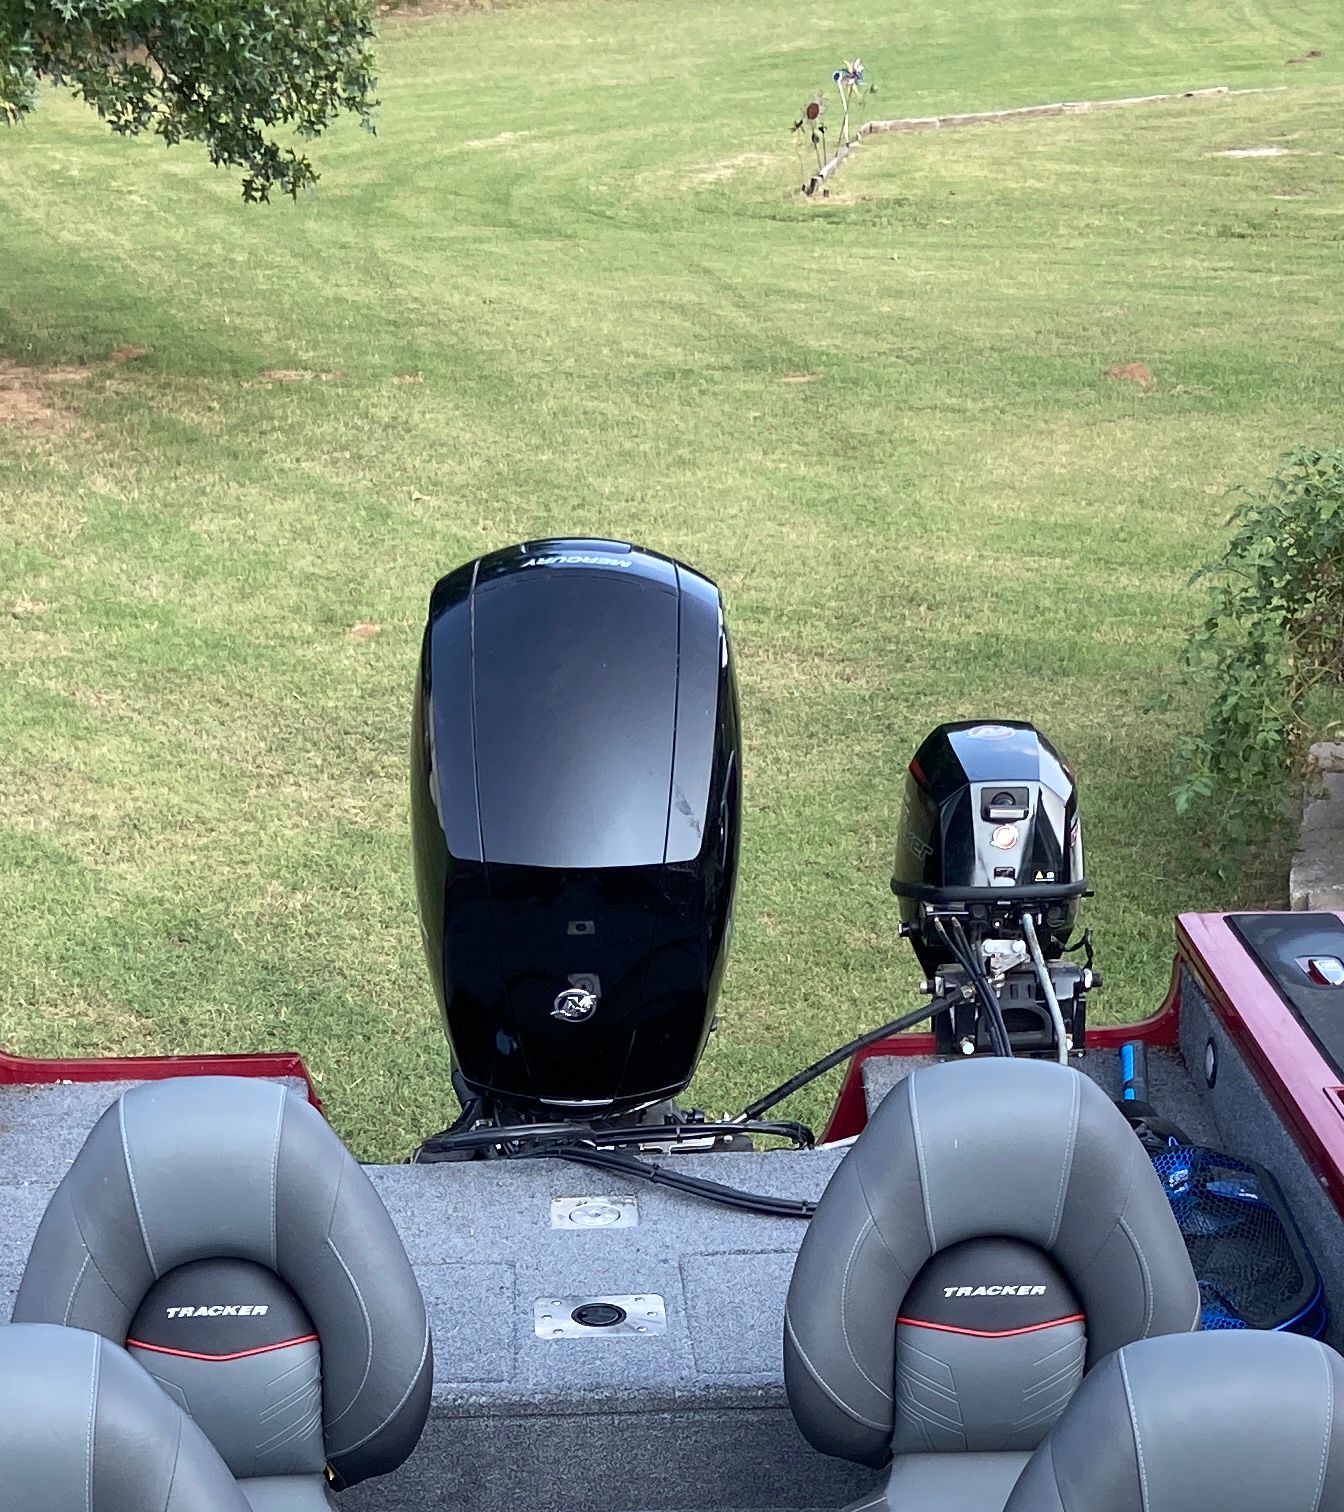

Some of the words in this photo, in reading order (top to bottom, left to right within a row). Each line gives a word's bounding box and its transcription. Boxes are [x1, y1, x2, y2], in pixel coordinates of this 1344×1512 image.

[520, 556, 632, 567] MERCURY
[943, 1285, 1046, 1297] TRACKER
[166, 1305, 269, 1318] TRACKER
